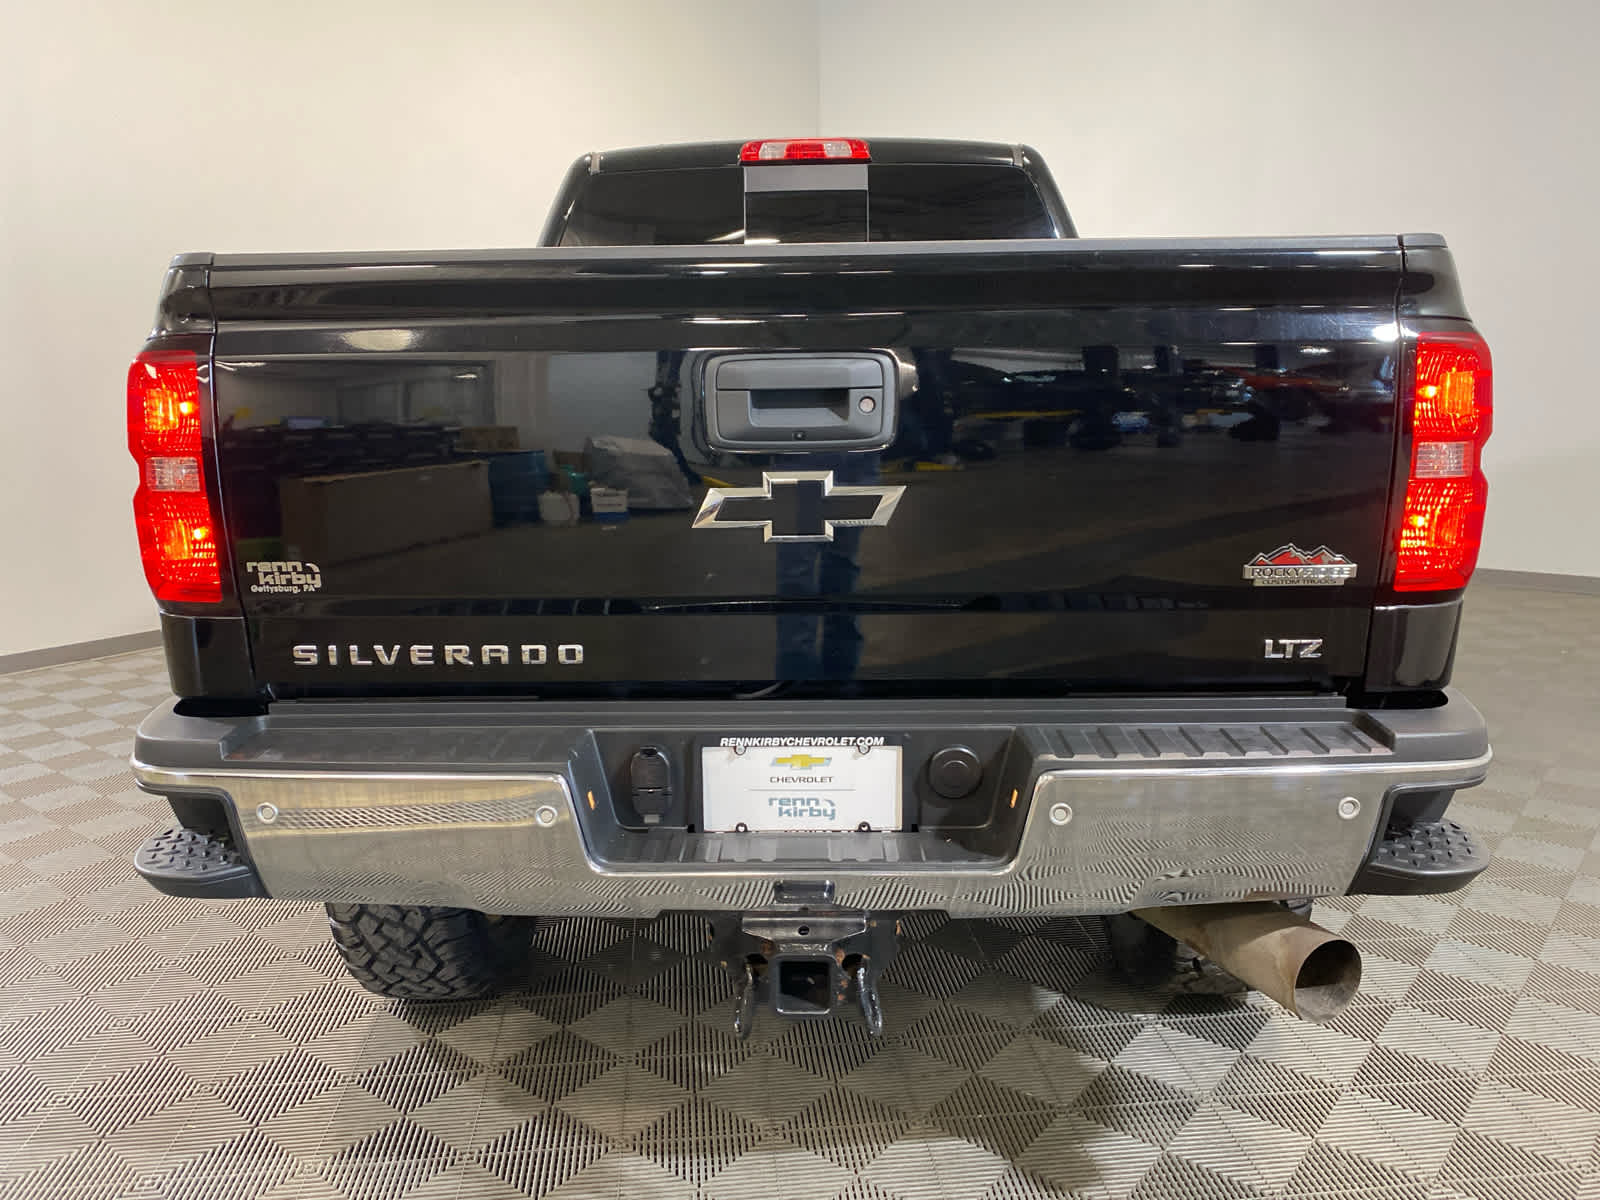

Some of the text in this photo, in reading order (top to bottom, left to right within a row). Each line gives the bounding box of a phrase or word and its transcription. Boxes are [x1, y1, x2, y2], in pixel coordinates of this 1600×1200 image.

[246, 561, 303, 572] renn
[1251, 567, 1300, 577] ROCKY
[258, 571, 322, 588] kirby
[303, 584, 316, 592] PA
[1264, 639, 1323, 658] LTZ
[292, 644, 584, 665] SILVERADO
[720, 736, 885, 747] RENNKIRBYCHEVROLET.COM
[768, 797, 819, 806] renn
[777, 805, 836, 820] kirby
